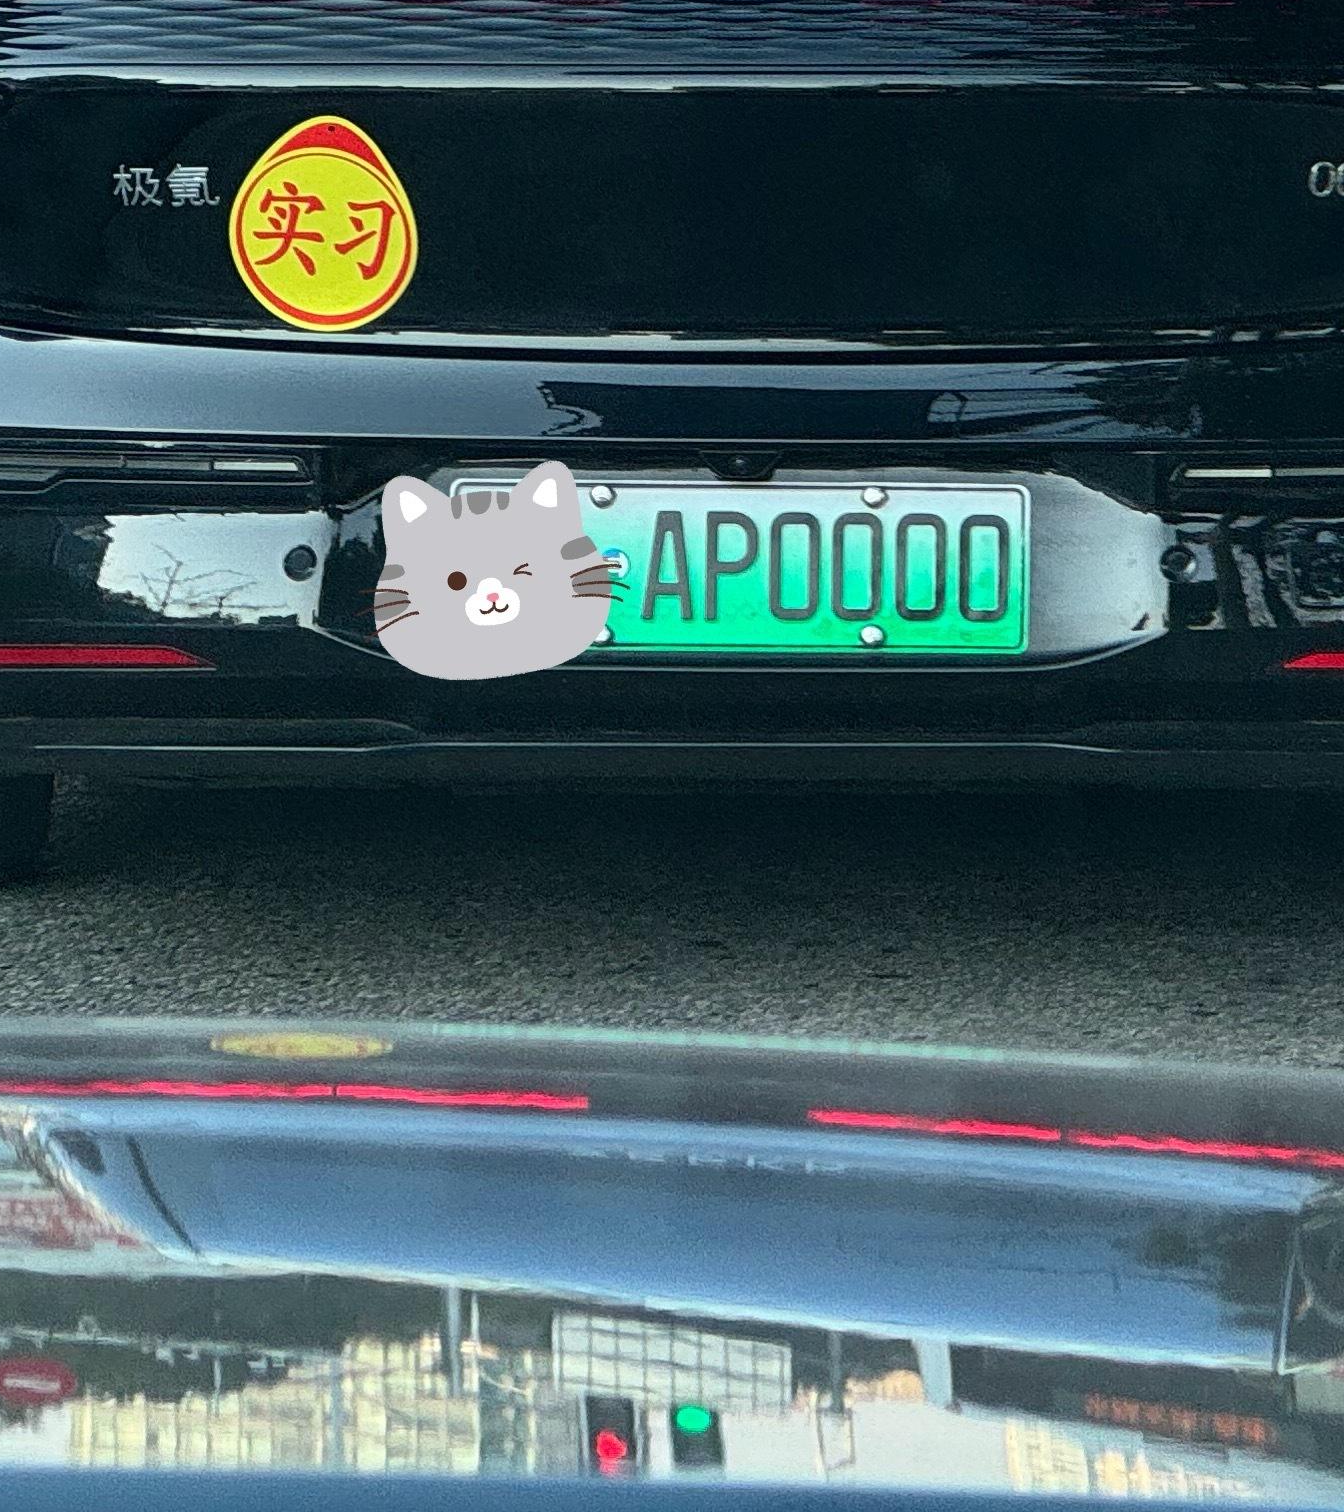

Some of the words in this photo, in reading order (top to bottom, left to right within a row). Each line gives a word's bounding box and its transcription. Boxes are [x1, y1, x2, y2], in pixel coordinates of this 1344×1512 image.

[112, 163, 221, 208] 极氪
[252, 180, 397, 281] 实习
[639, 509, 1012, 624] AP0000
